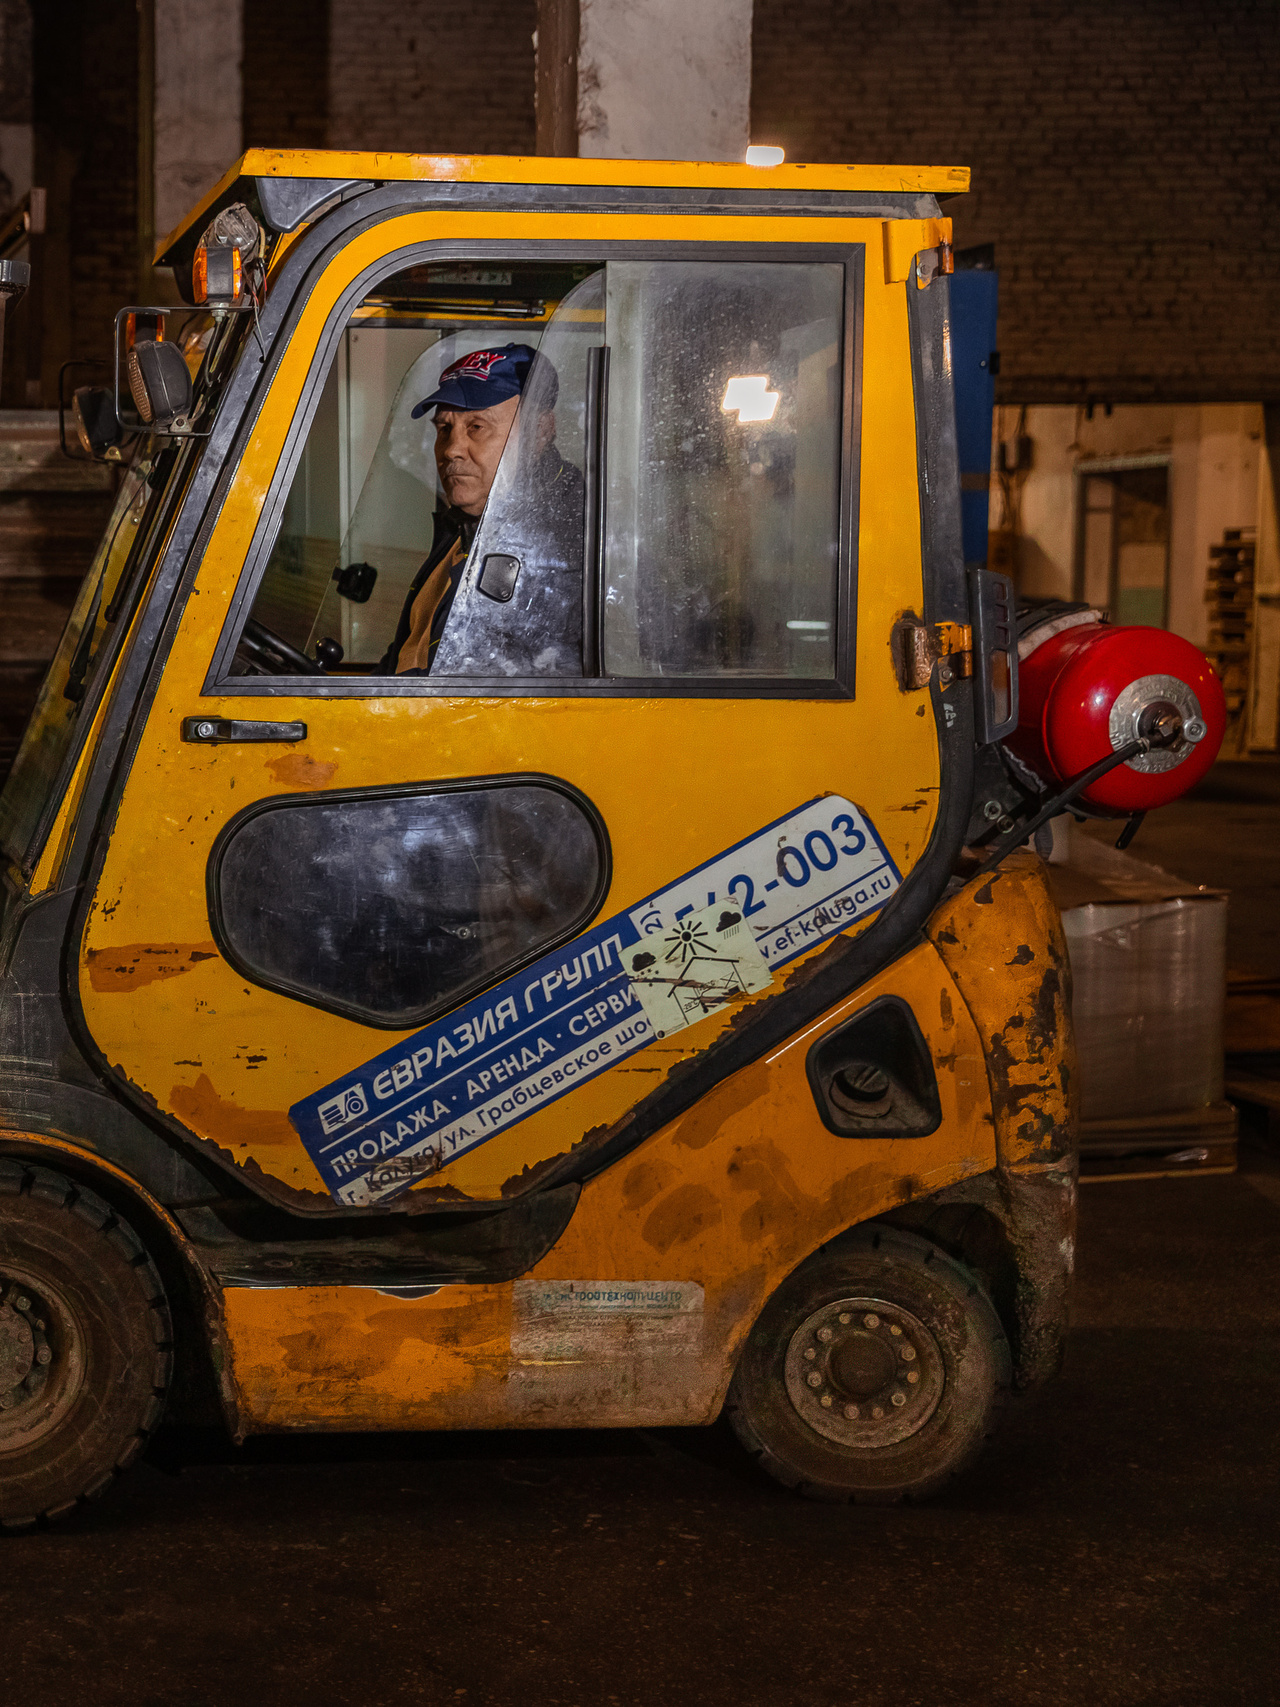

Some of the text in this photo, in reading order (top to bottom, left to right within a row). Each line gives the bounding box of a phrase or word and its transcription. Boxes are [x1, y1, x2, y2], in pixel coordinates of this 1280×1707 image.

[330, 984, 640, 1177] ПРОДАЖА АРЕНДА СЕРВИ
[373, 934, 623, 1100] ЕВРАЗИЯ ГРУПП
[444, 1126, 476, 1150] ул.
[476, 1040, 613, 1127] Грабцевское
